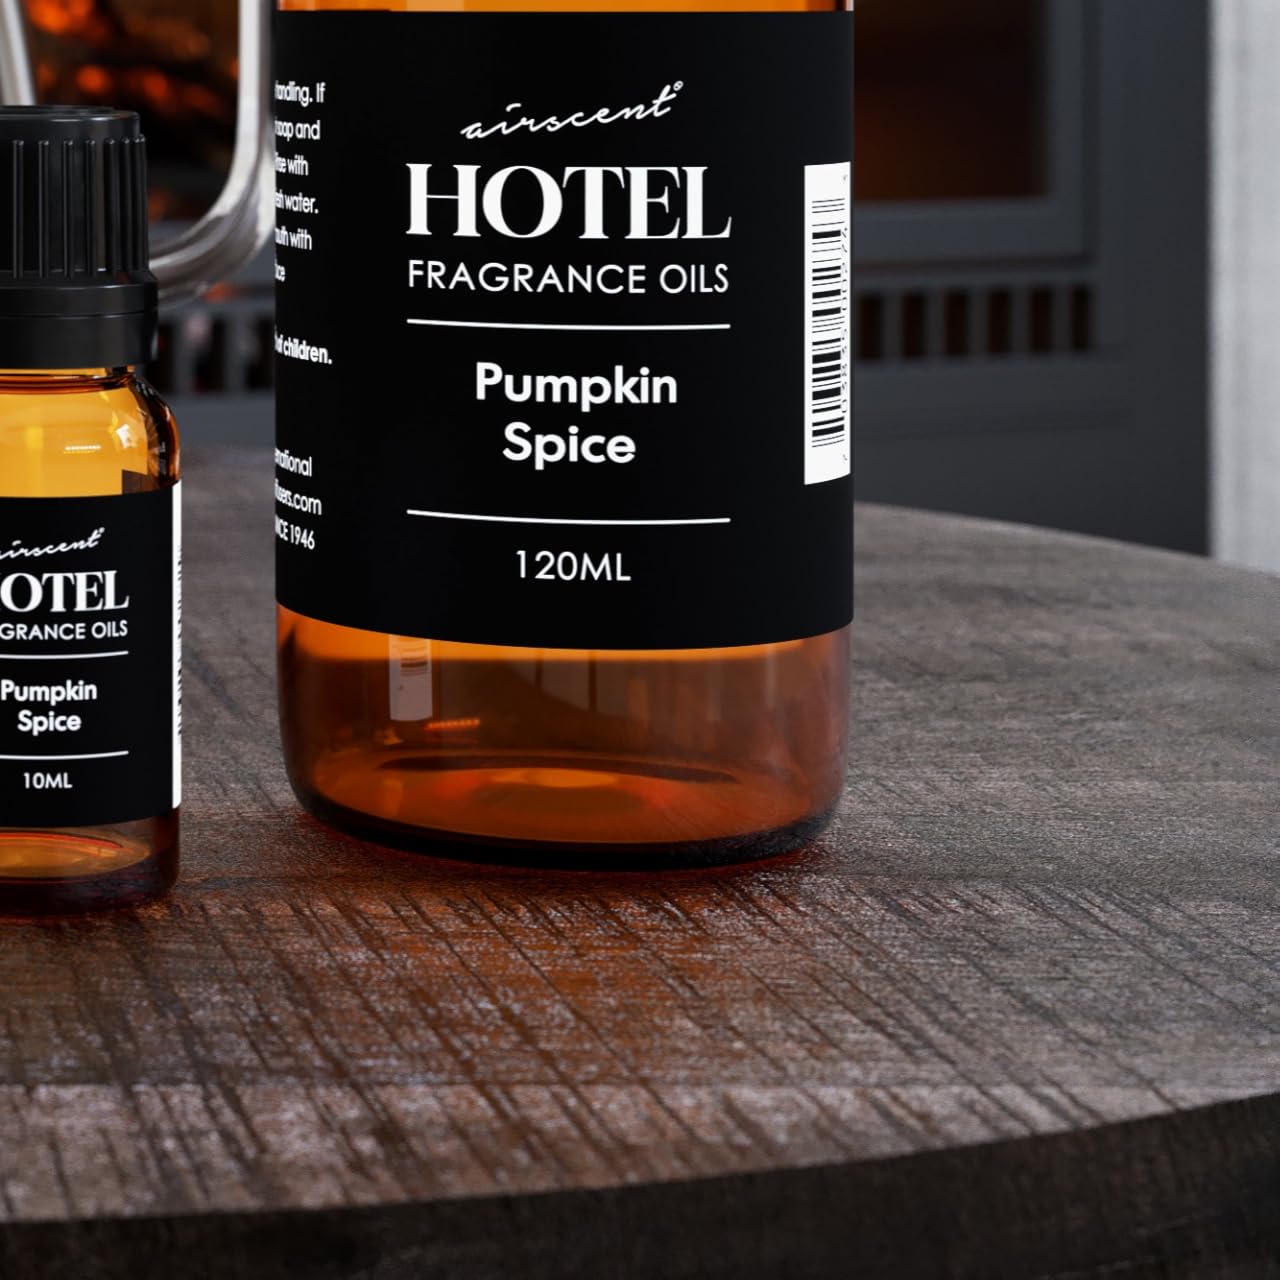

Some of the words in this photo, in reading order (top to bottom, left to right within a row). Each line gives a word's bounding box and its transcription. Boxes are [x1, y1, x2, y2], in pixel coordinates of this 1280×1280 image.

[316, 82, 326, 103] If
[295, 120, 321, 140] and
[287, 154, 309, 176] with
[285, 192, 320, 215] water.
[406, 163, 731, 239] HOTEL
[289, 228, 313, 250] with
[409, 260, 645, 294] FRAGRANCE
[660, 264, 728, 293] OILS
[283, 336, 333, 365] children.
[477, 362, 677, 412] Pumpkin
[503, 422, 636, 470] Spice
[289, 524, 316, 550] 1946
[517, 550, 631, 581] 120ML
[92, 620, 127, 638] OILS
[1, 679, 97, 706] Pumpkin
[18, 710, 81, 736] Spice
[24, 773, 72, 789] 10ML
